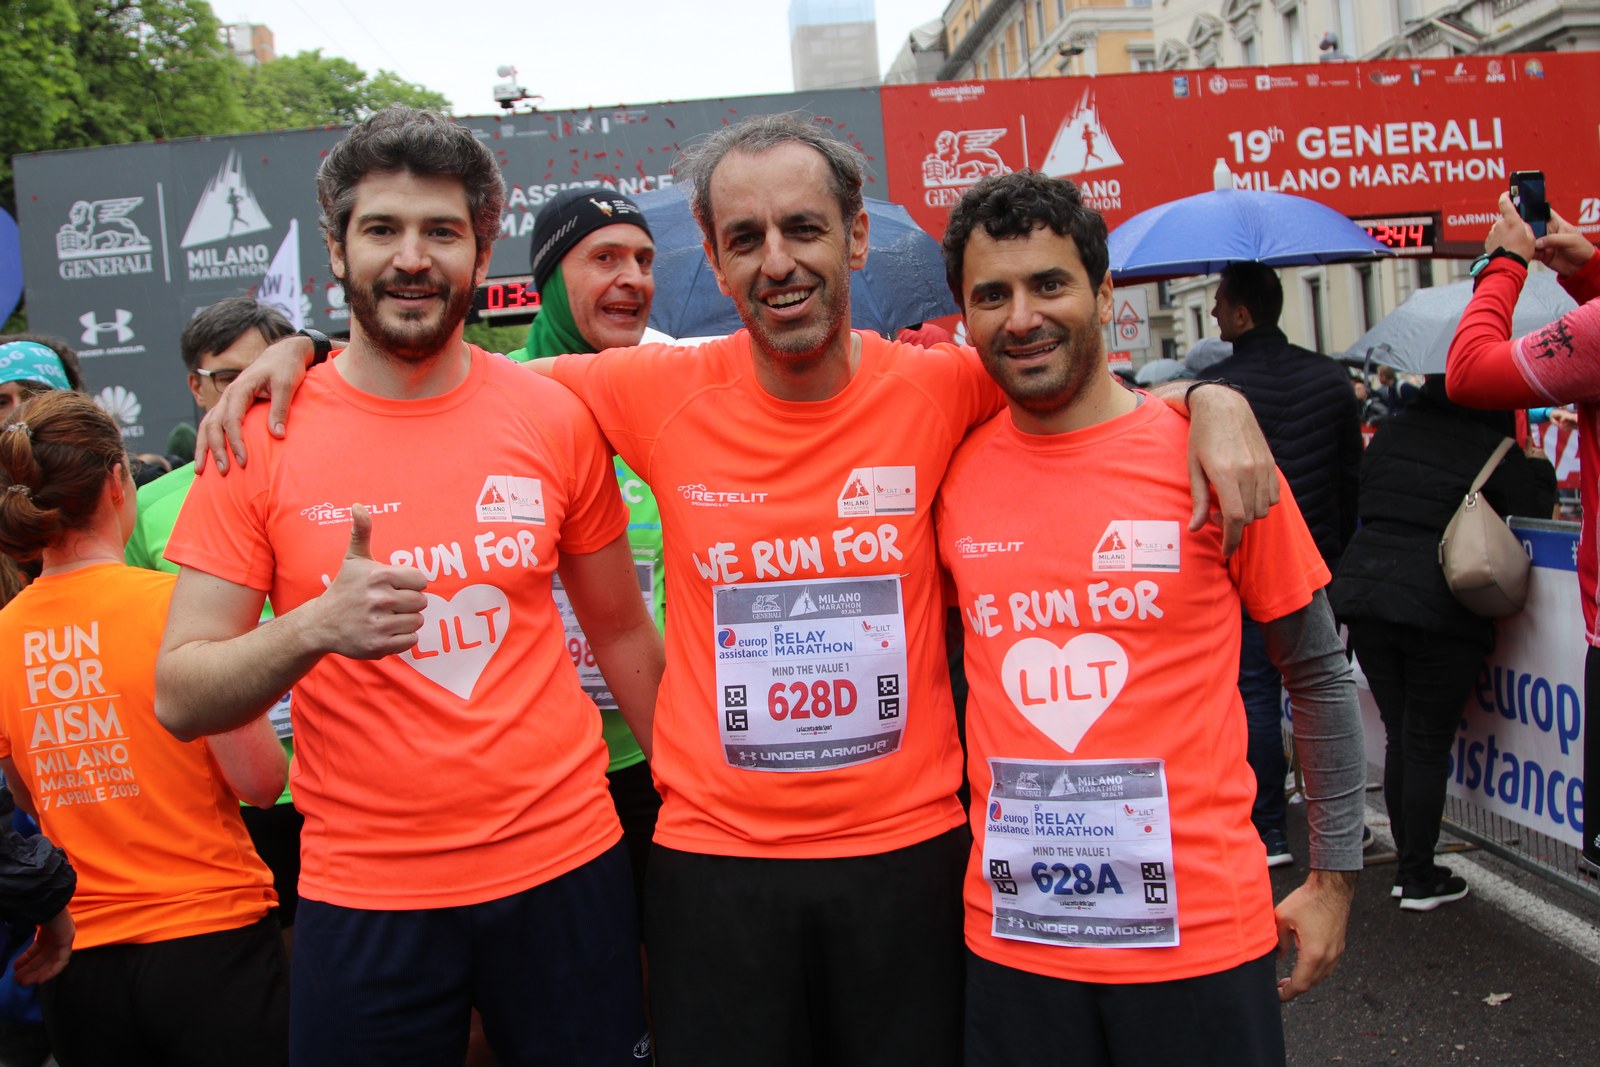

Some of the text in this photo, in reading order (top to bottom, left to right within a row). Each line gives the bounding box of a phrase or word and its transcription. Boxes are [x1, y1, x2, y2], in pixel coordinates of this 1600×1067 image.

[1297, 117, 1503, 160] GENERALI
[1231, 157, 1505, 191] MILANO MARATHON
[187, 244, 269, 268] MILANO
[58, 253, 153, 280] GENERALI
[188, 263, 269, 280] MARATHON
[691, 490, 769, 503] RETELIT
[474, 529, 539, 572] FOR
[692, 523, 904, 584] WE RUN FOR
[962, 541, 1025, 553] RETELIT
[818, 592, 861, 604] MILANO
[818, 602, 862, 611] MARATHON
[966, 580, 1164, 638] WE RUN FOR
[24, 620, 100, 667] RUN
[738, 637, 768, 648] europ
[774, 630, 827, 645] RELAY
[719, 649, 769, 660] assistance
[775, 642, 853, 656] MARATHON
[772, 662, 850, 677] MIND THE VALUE 1
[26, 658, 106, 704] FOR
[1019, 660, 1118, 707] LILT
[768, 679, 858, 721] 628D
[30, 701, 124, 749] AISM
[760, 740, 888, 762] UNDER ARMOUR
[35, 743, 129, 777] MILANO
[40, 766, 135, 793] MARATHON
[1077, 775, 1123, 786] MILANO
[41, 783, 140, 811] 7 APRILE 2019
[1078, 785, 1124, 793] MARATHON
[1003, 814, 1029, 826] europ
[1034, 813, 1086, 825] RELAY
[1138, 808, 1155, 816] LILT
[988, 823, 1030, 835] assistance
[1035, 826, 1114, 837] MARATHON
[1033, 846, 1111, 857] MIND THE VALUE 1
[1031, 861, 1124, 896] 628A
[1026, 921, 1079, 935] UNDER
